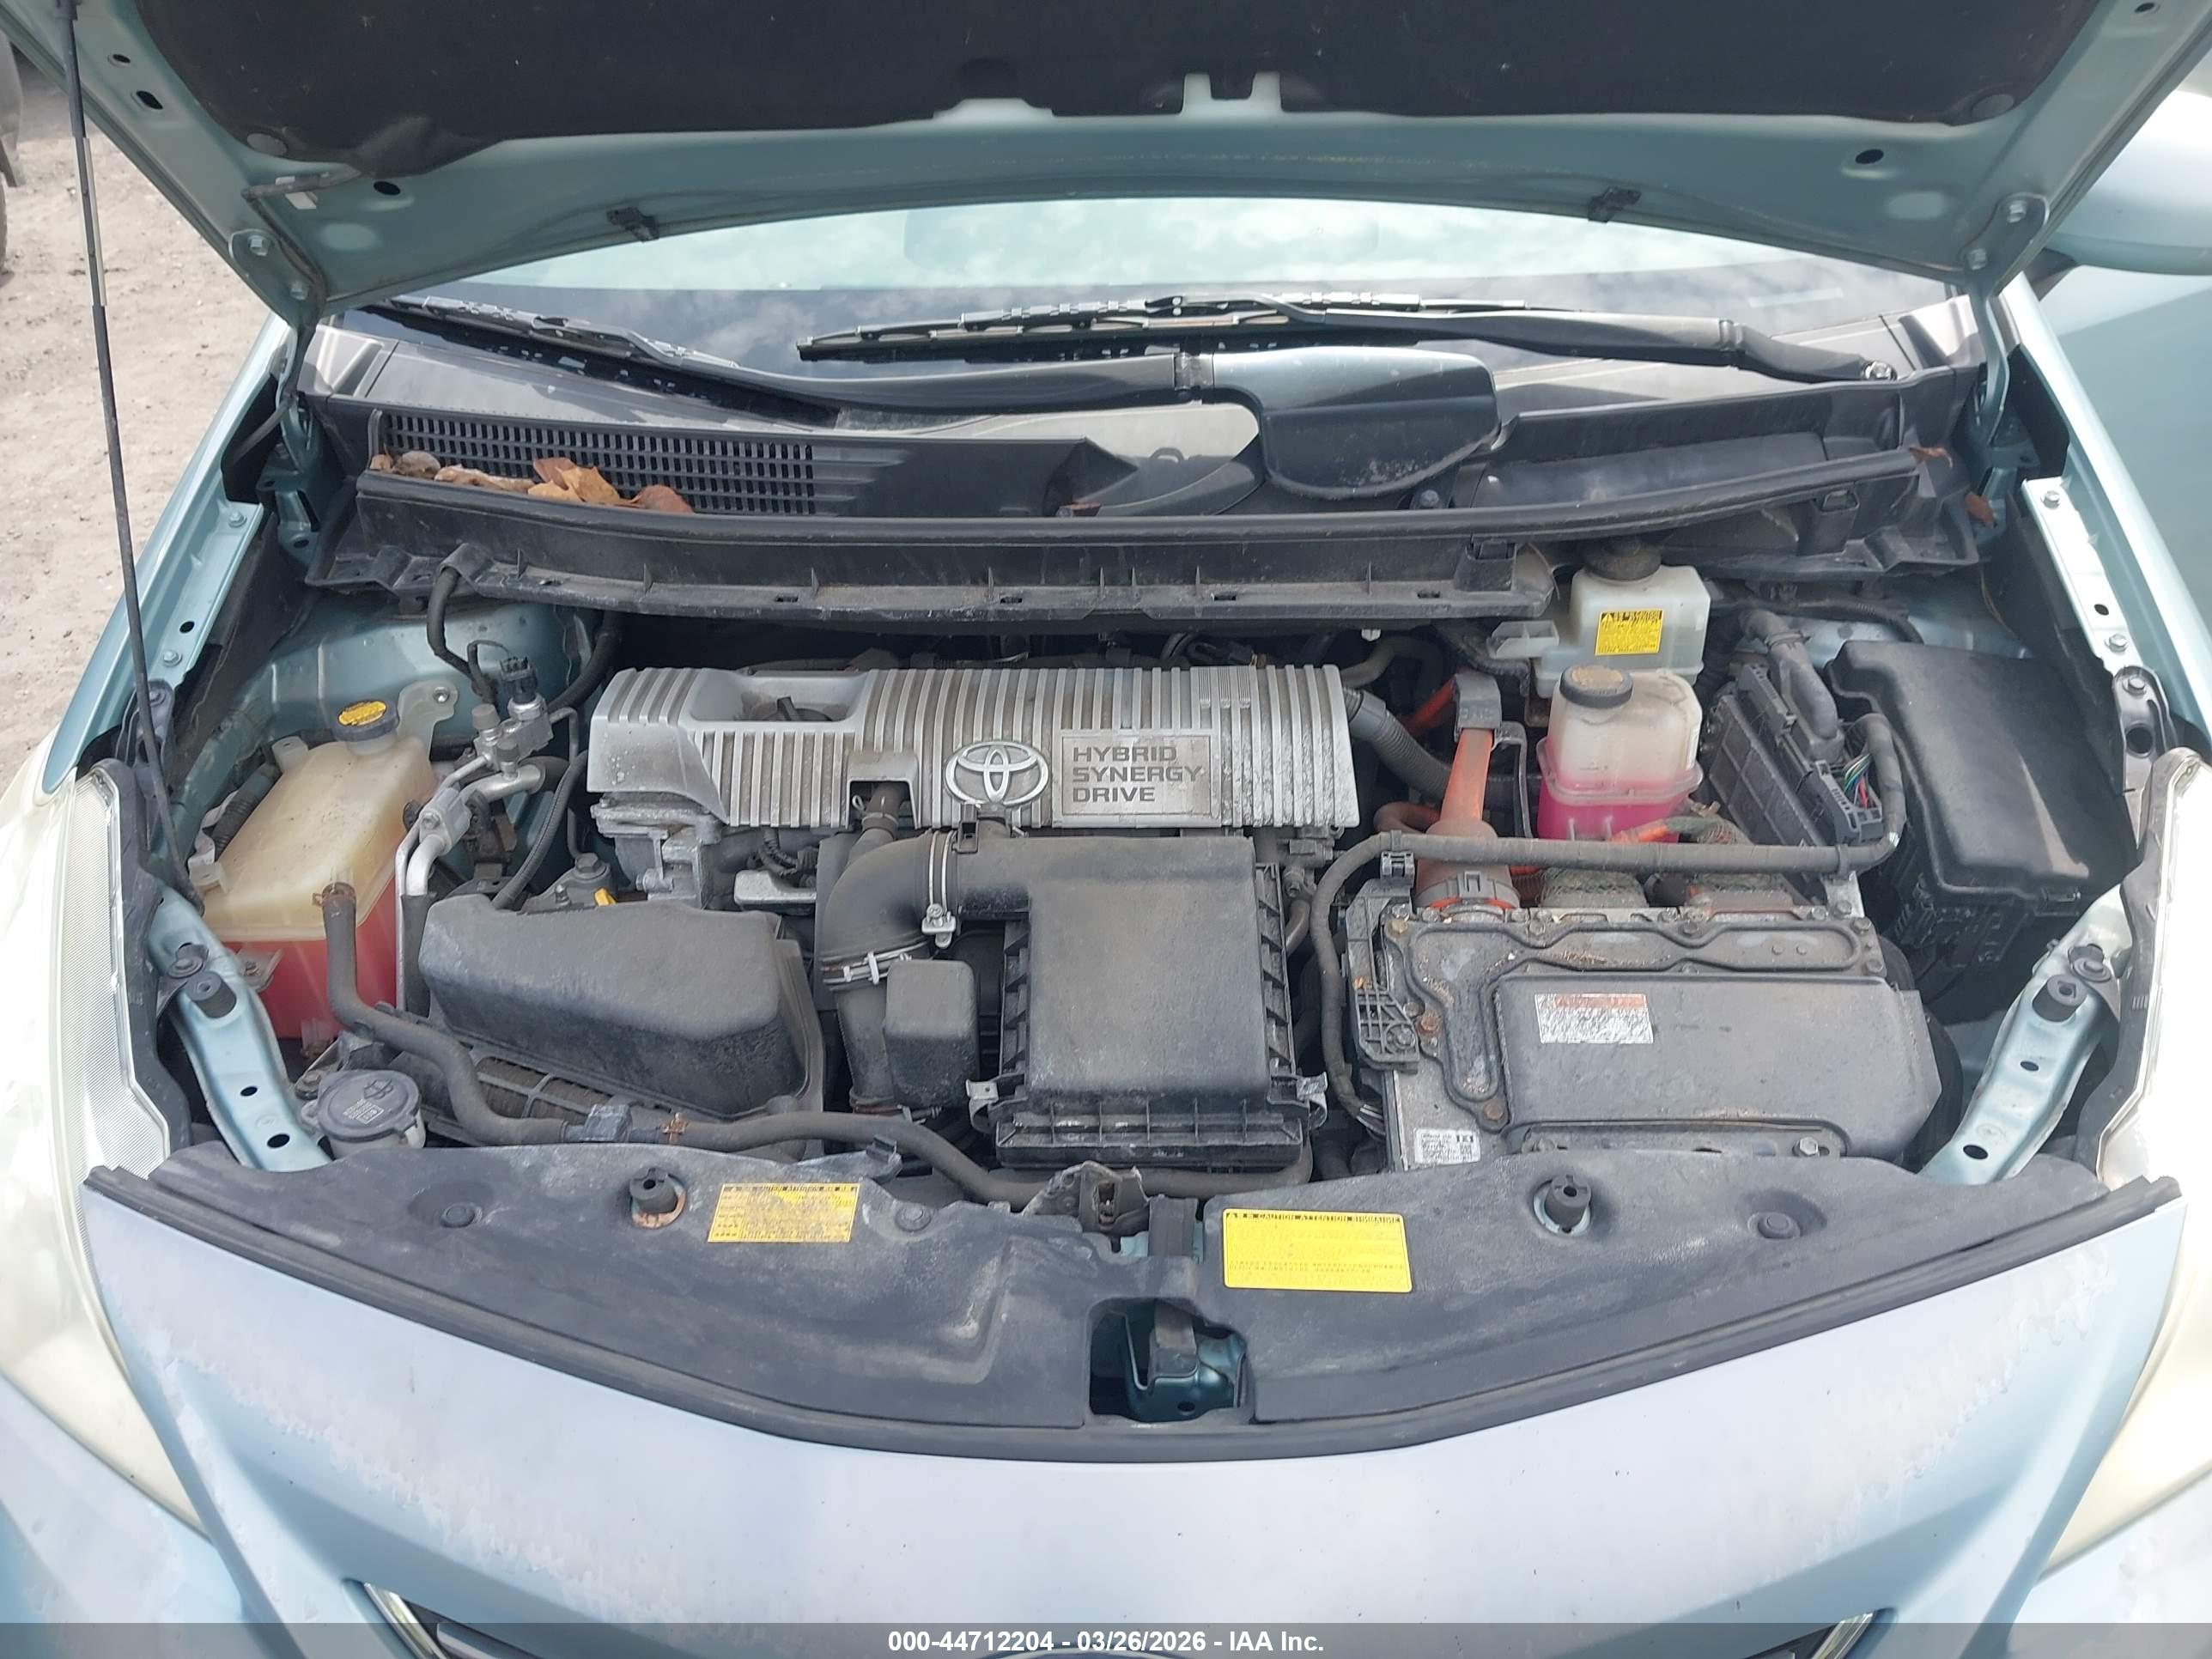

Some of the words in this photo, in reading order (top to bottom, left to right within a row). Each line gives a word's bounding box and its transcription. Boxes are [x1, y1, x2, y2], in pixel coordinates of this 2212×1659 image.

[1073, 746, 1176, 762] HYBRID
[1073, 766, 1202, 782] SYNERGY
[1073, 787, 1155, 802] DRIVE
